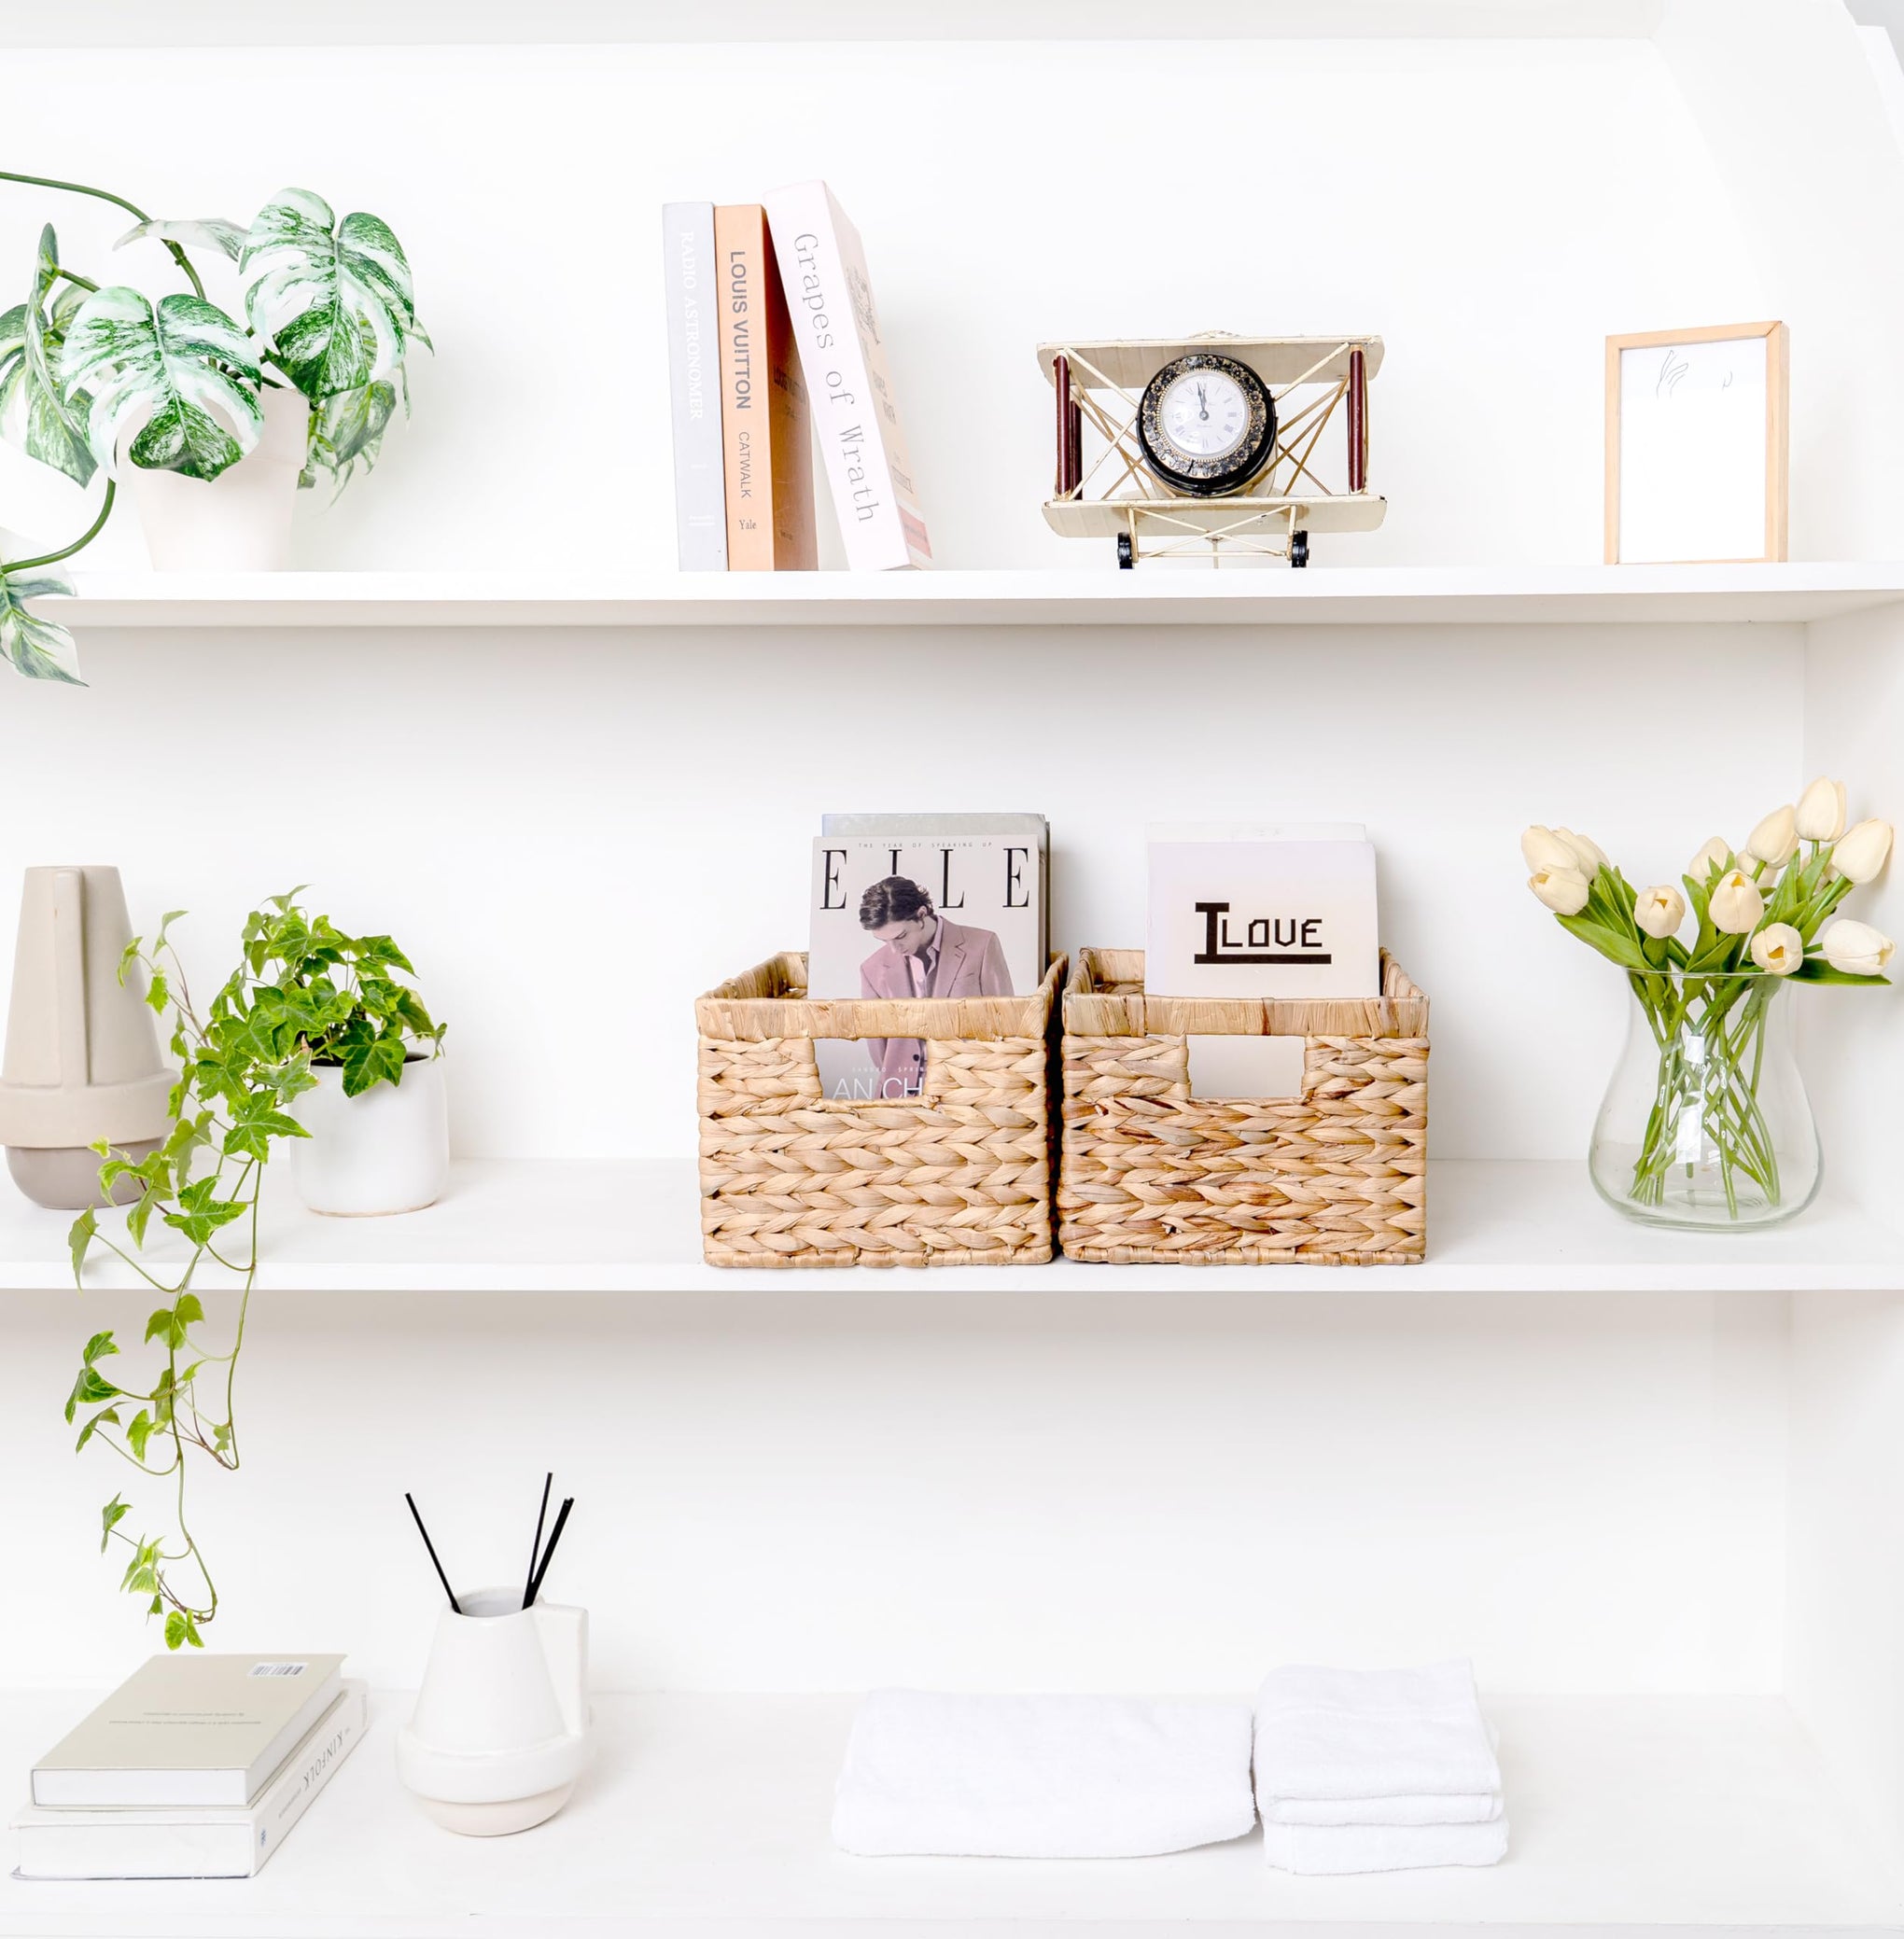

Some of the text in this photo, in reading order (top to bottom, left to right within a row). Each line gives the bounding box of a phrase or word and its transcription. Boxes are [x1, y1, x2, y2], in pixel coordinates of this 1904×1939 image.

[679, 231, 705, 420] RADIO ASTRONOMER
[730, 251, 751, 410] LOUIS VUITTON
[794, 232, 880, 523] Grapes of Wrath
[738, 432, 752, 498] CATWALK
[738, 519, 757, 530] Yale
[1222, 919, 1322, 947] LOVE
[833, 1078, 873, 1099] AN
[302, 1731, 343, 1790] KINFOLK
